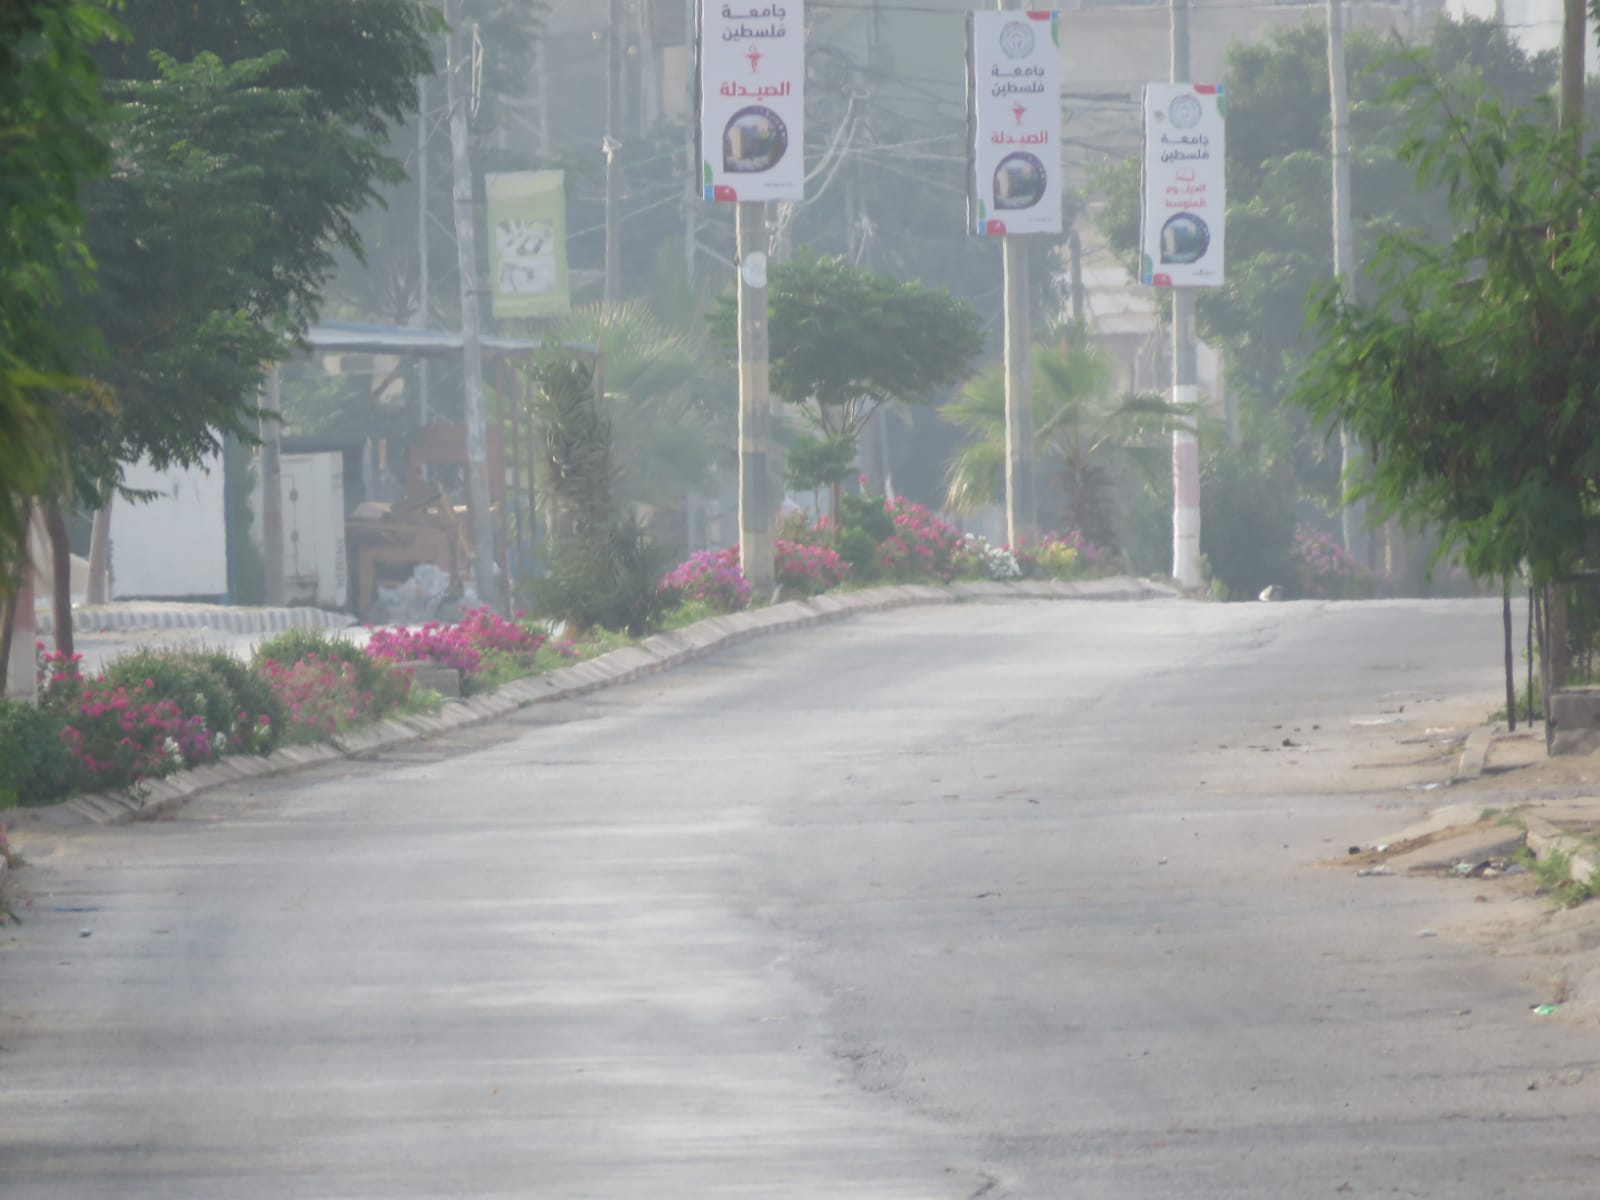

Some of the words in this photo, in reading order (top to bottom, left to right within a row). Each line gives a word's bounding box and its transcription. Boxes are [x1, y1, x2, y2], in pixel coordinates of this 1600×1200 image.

[722, 23, 786, 42] فلسطين
[720, 81, 791, 101] الصيدلة
[991, 80, 1045, 97] فلسطين
[991, 130, 1049, 147] الصيدلة
[1160, 148, 1209, 164] فلسطين
